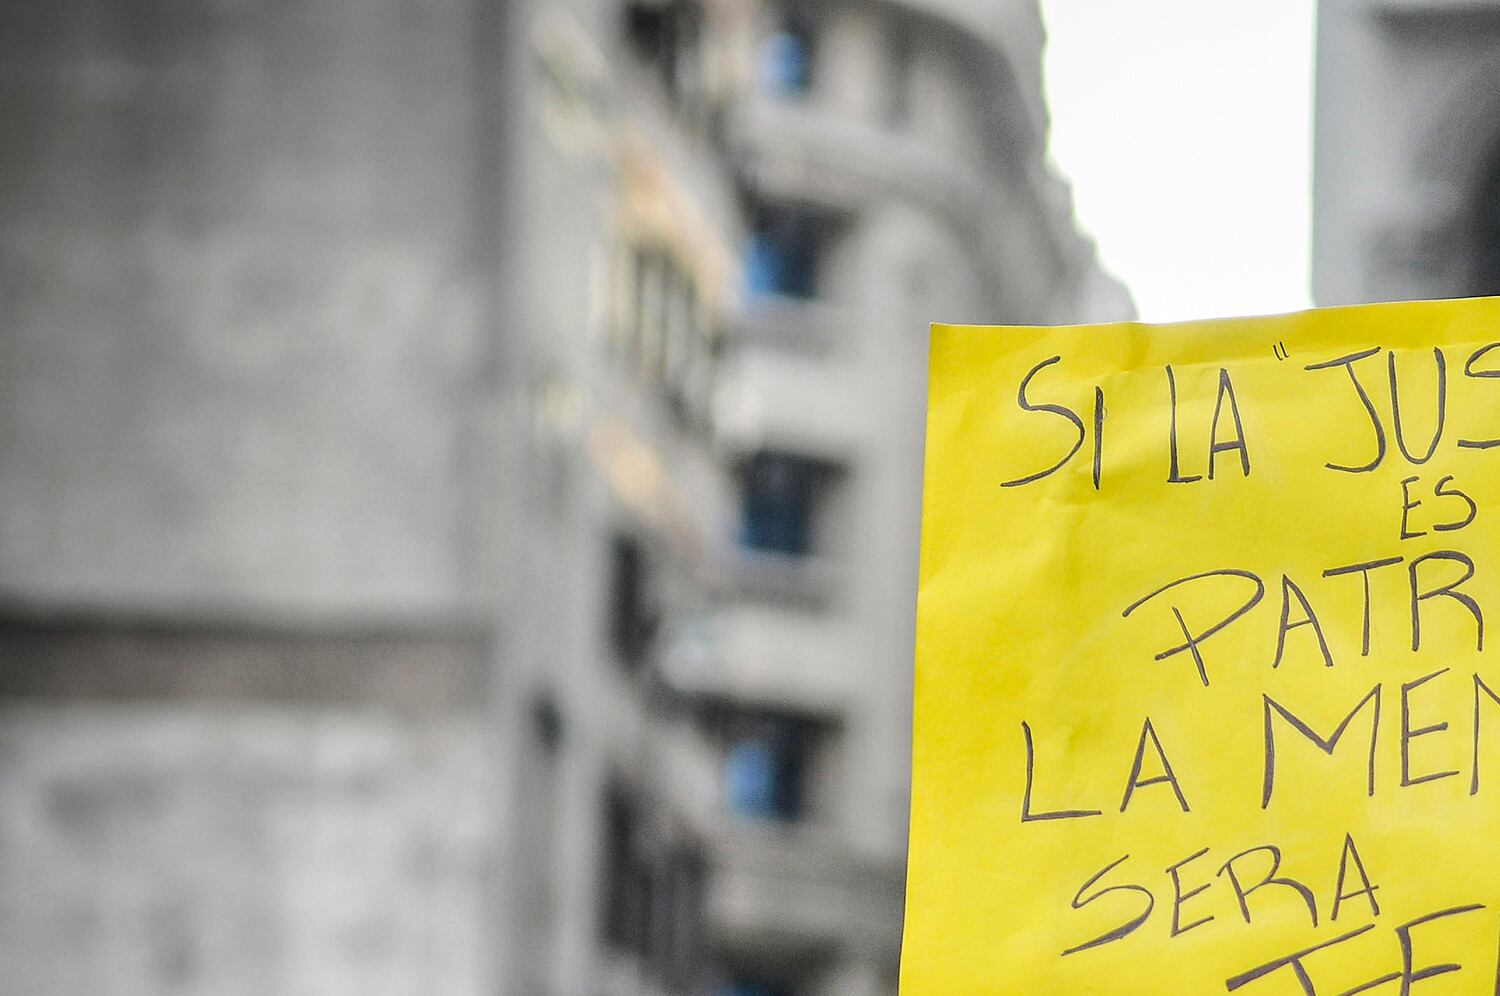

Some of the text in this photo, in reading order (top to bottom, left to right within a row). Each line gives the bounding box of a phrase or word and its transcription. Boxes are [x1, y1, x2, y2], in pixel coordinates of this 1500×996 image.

[1000, 356, 1107, 490] SI
[1165, 365, 1250, 483] LA
[1400, 475, 1477, 540] ES
[1021, 717, 1190, 823] LA
[1061, 832, 1380, 956] SERA
